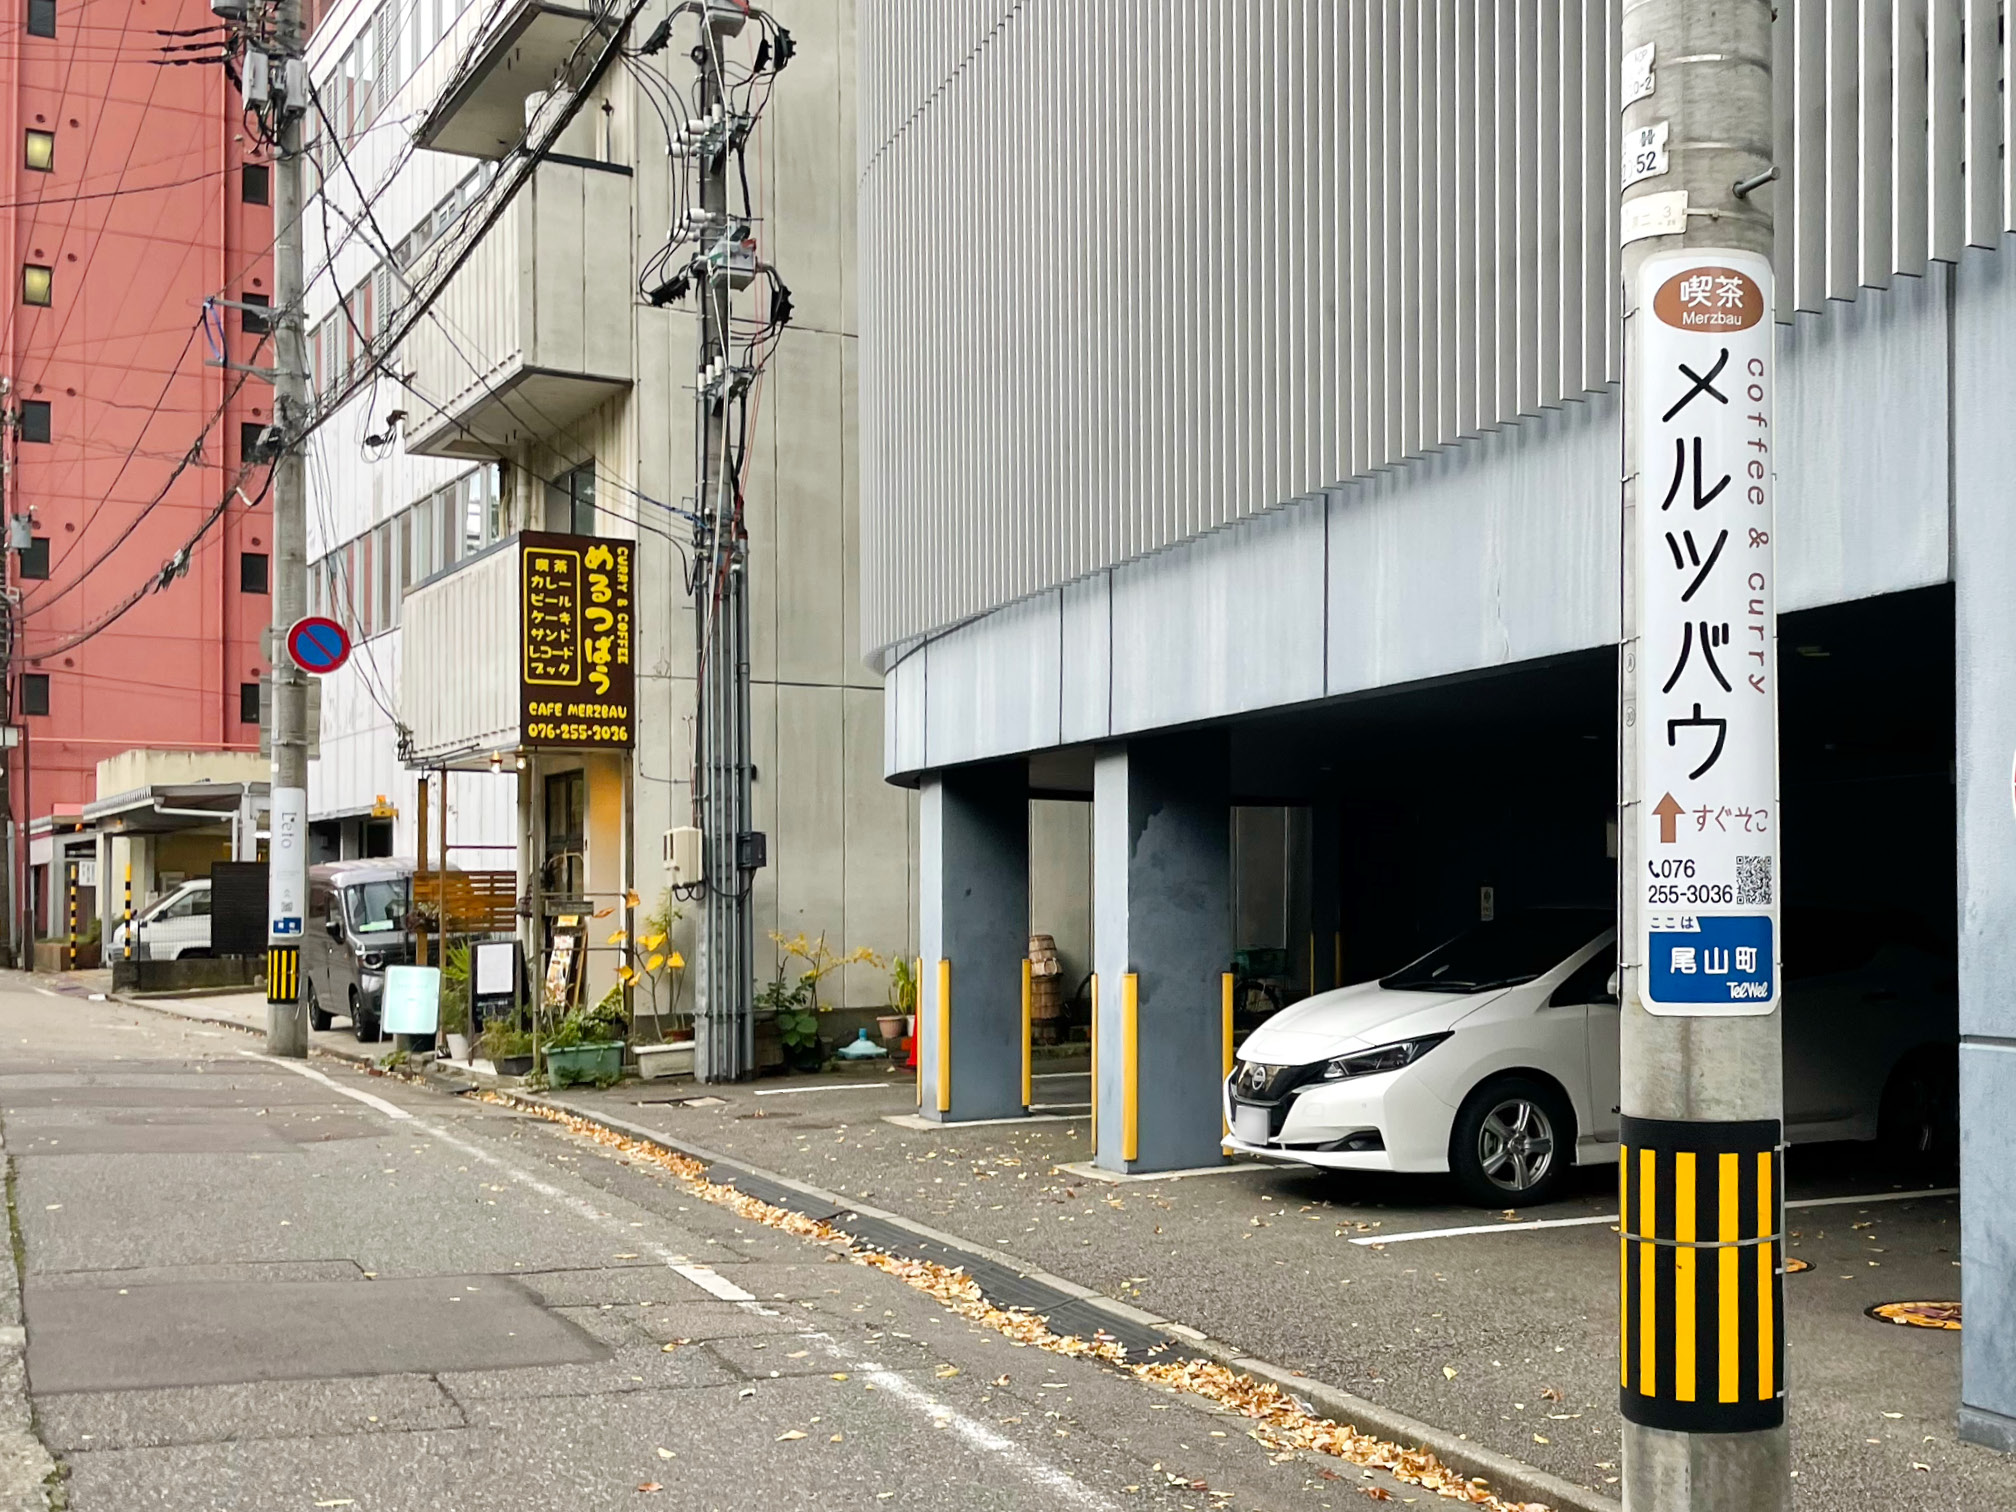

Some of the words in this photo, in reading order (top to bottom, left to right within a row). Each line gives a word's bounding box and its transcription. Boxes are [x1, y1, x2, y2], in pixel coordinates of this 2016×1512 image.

[1679, 275, 1744, 308] 喫茶
[1681, 311, 1742, 326] Merzbau
[1747, 357, 1768, 506] coffee
[1749, 527, 1769, 548] &
[616, 546, 629, 593] CURRY
[1661, 347, 1733, 780] メルツバウ
[531, 575, 572, 589] カレー
[531, 592, 572, 608] ビール
[531, 610, 571, 625] ケーキ
[531, 627, 571, 642] サンド
[616, 612, 629, 665] COFFEE
[1747, 572, 1766, 695] curry
[529, 645, 574, 660] レコード
[529, 702, 562, 717] CAFE
[567, 703, 627, 719] MERZBAU
[1692, 804, 1769, 833] すぐそこ
[1661, 859, 1696, 878] 076
[1648, 885, 1733, 904] 255-3036
[1651, 916, 1694, 929] ここは
[1670, 947, 1758, 974] 尾山町
[1726, 981, 1768, 999] TelWel
